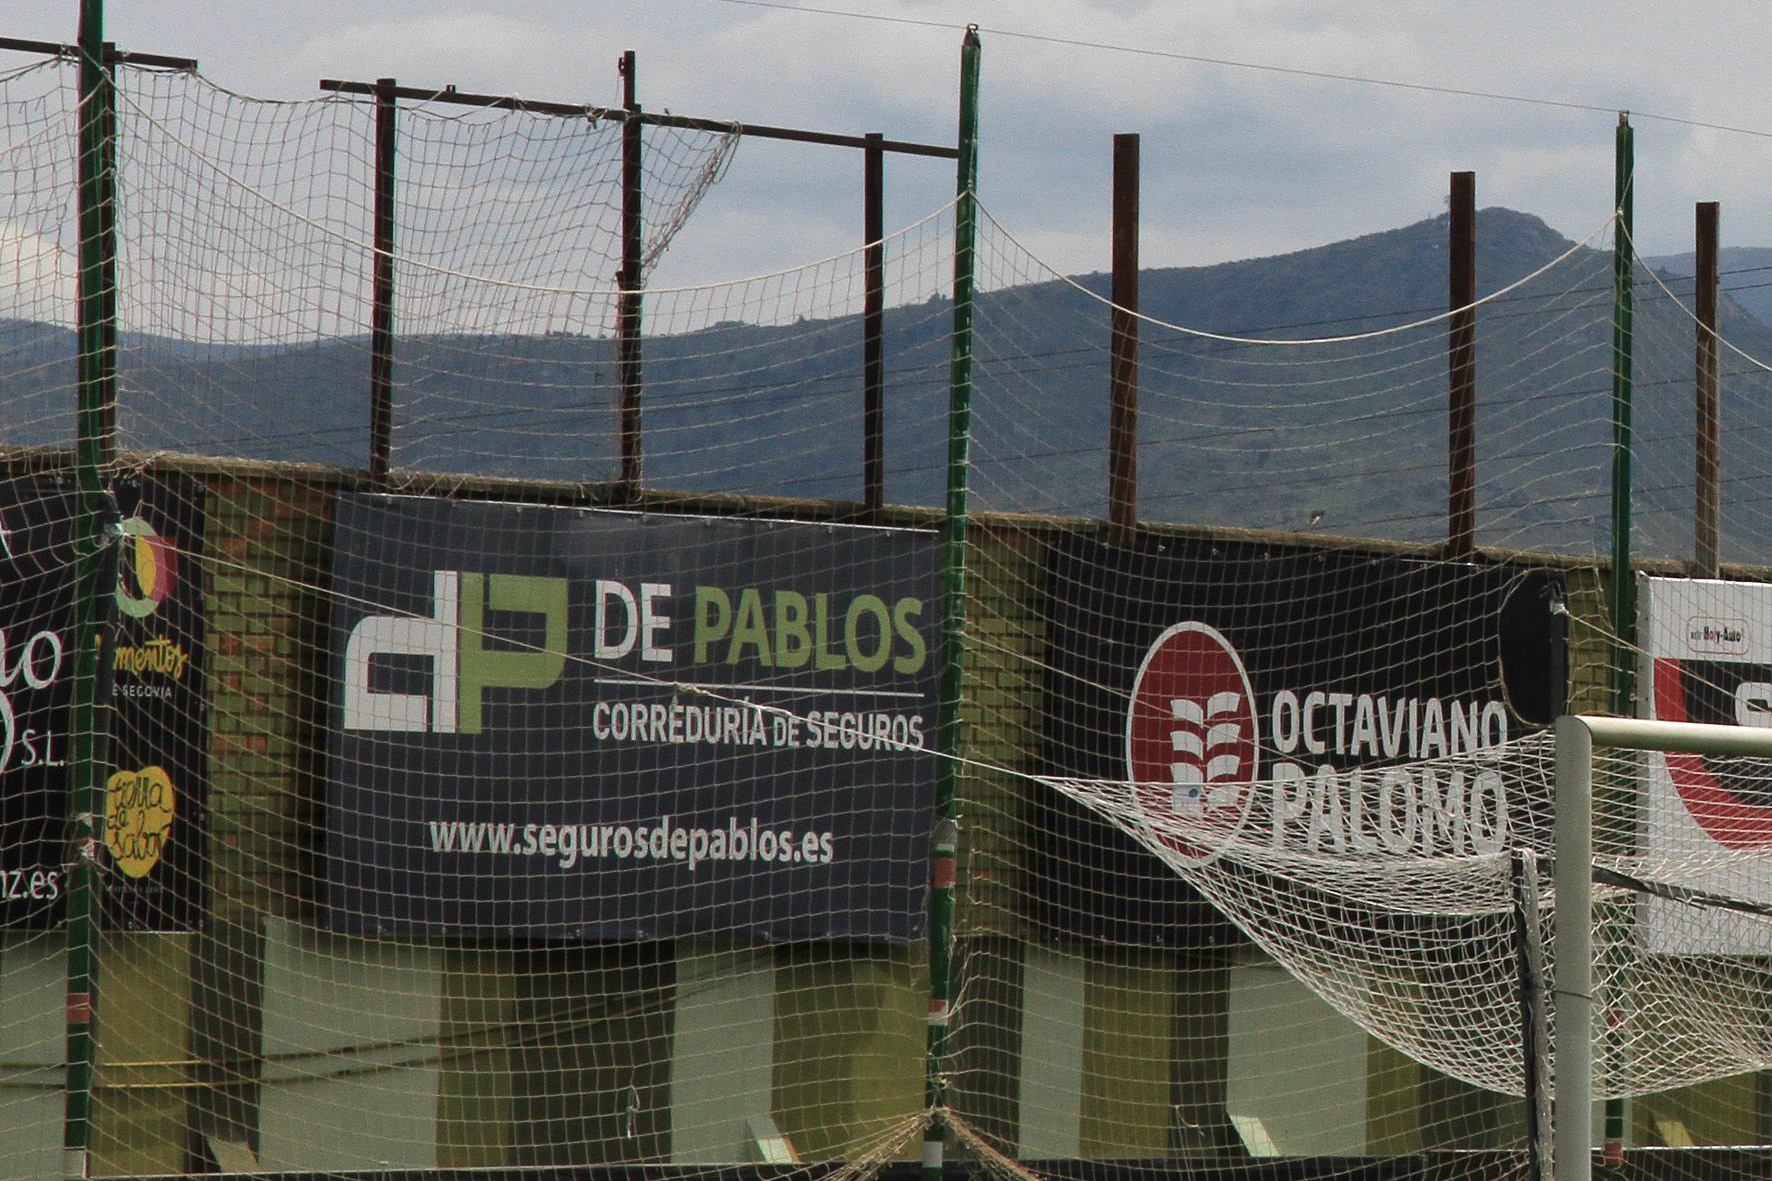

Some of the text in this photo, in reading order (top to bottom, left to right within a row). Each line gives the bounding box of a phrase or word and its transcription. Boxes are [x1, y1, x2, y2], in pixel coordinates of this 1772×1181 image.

[594, 579, 927, 675] DE PABLOS
[113, 634, 189, 680] mentos
[123, 683, 173, 698] SEGOVIA
[21, 729, 65, 767] S.L.
[593, 697, 925, 752] CORREDURÍA DE SEGUROS
[1272, 690, 1508, 760] OCTAVIANO
[1272, 763, 1507, 858] PALOMO
[429, 815, 834, 871] www.segurosdepablos.es
